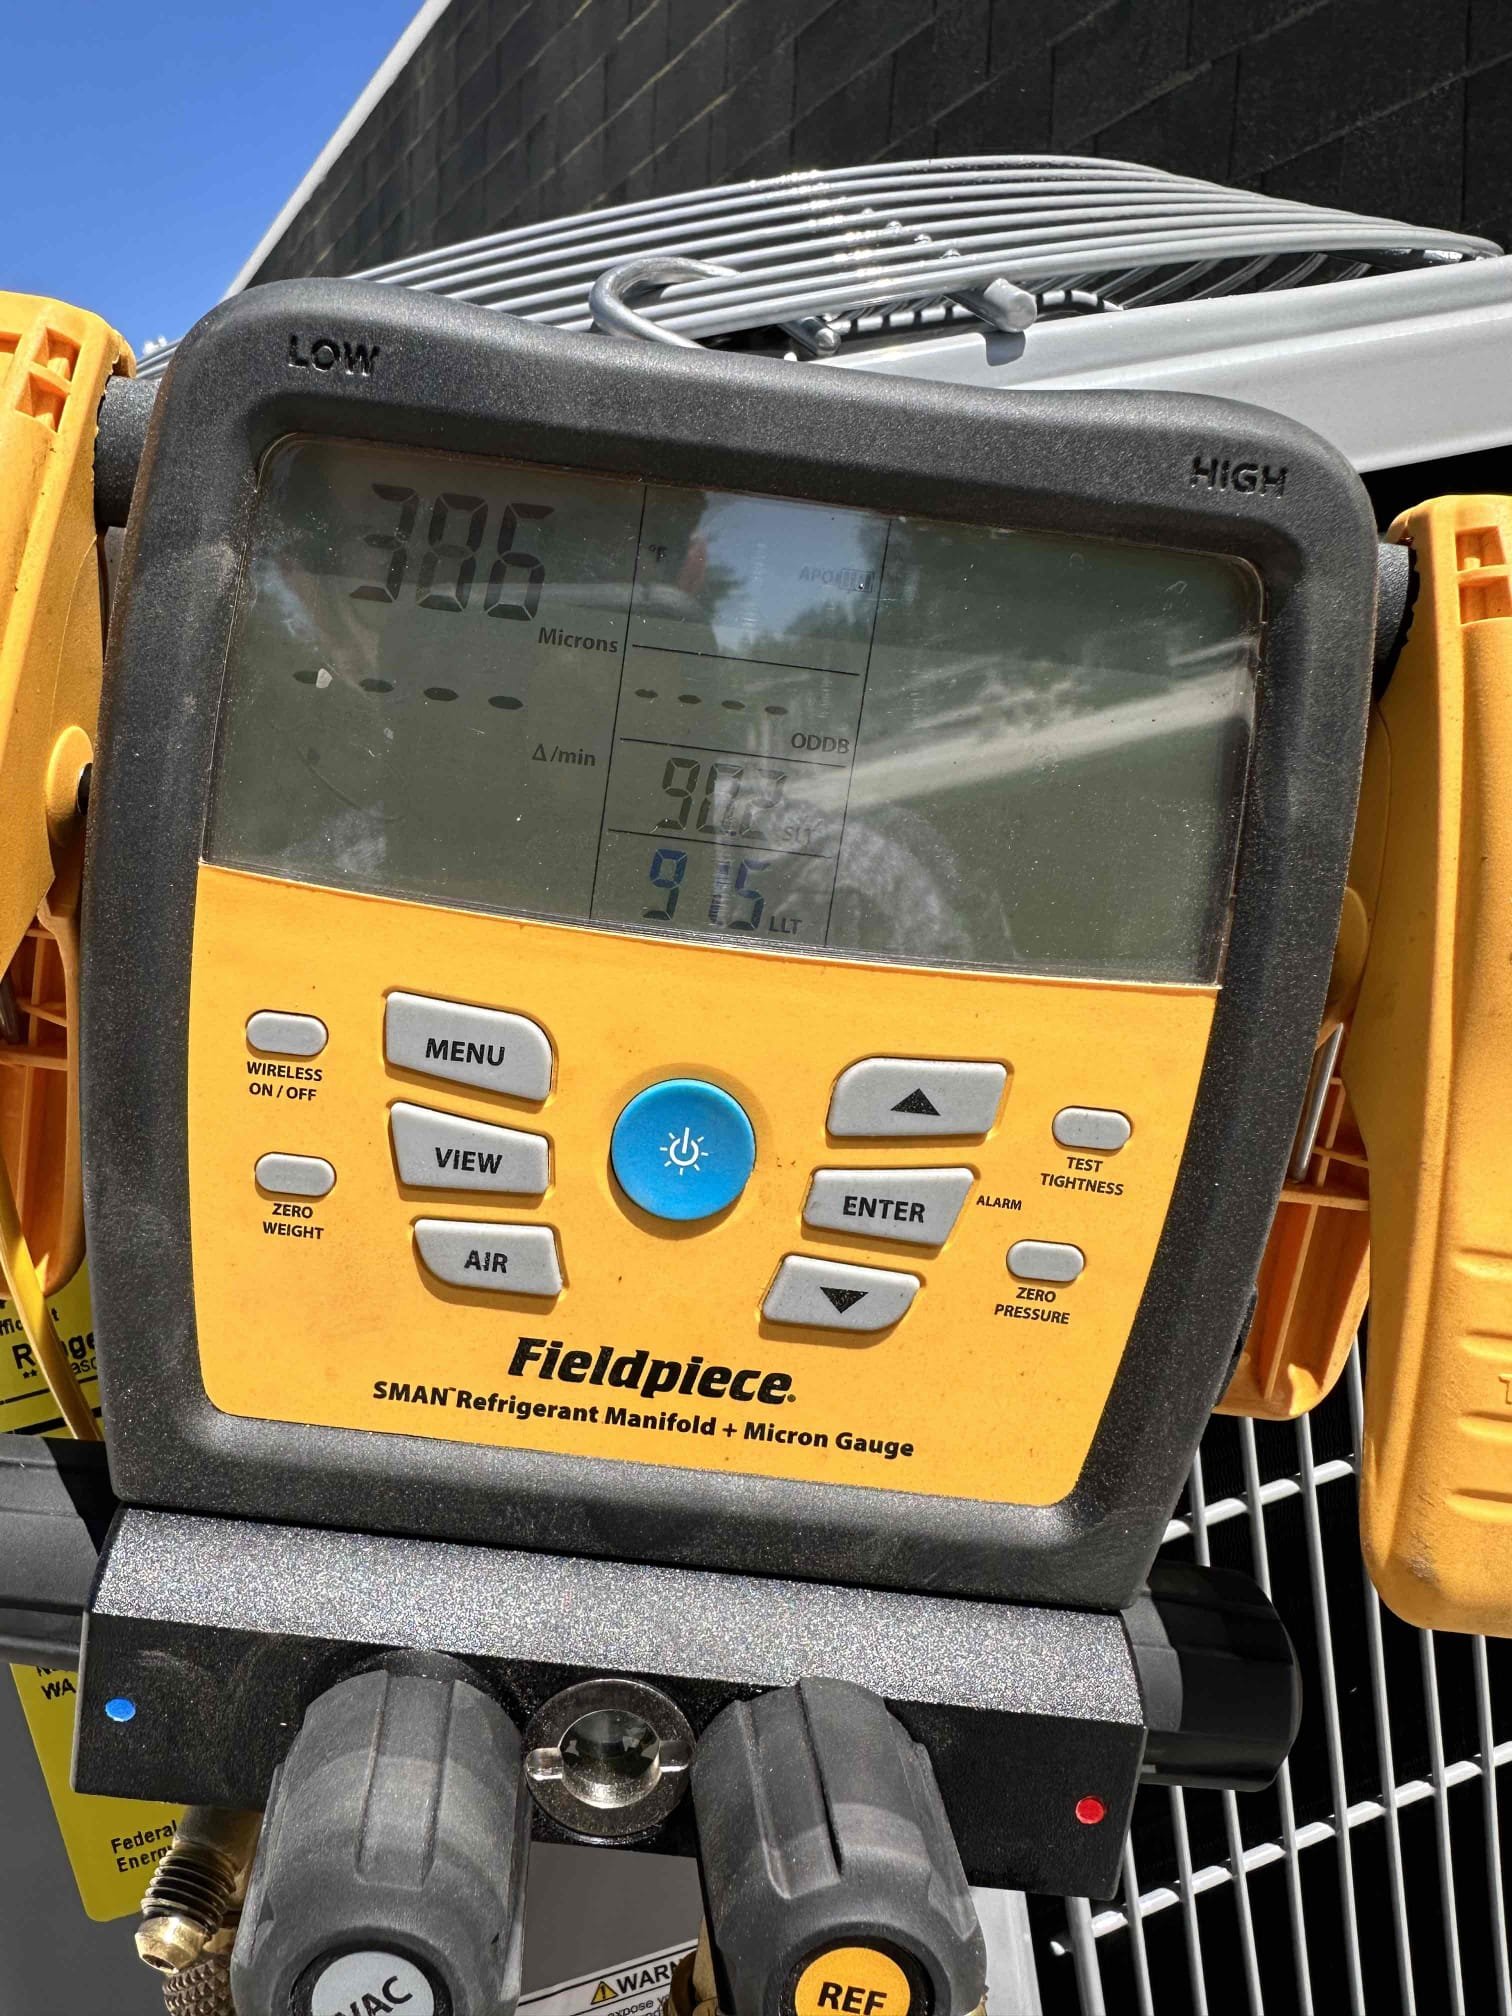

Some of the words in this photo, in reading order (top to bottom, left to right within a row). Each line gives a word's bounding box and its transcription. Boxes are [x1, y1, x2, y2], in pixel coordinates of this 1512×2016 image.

[288, 335, 381, 376] LOW
[1190, 457, 1288, 499] HIGH
[350, 483, 555, 621] 386
[538, 626, 619, 653] Microns
[791, 732, 850, 754] ODDB
[769, 915, 803, 934] LLT
[425, 1037, 506, 1067] MENU
[247, 1061, 323, 1082] WIRELESS
[249, 1083, 273, 1098] ON
[286, 1086, 317, 1101] OFF
[435, 1147, 503, 1174] VIEW
[1066, 1156, 1103, 1173] TEST
[1040, 1173, 1124, 1196] TIGHTNESS
[272, 1202, 313, 1219] ZERO
[842, 1195, 925, 1224] ENTER
[976, 1195, 1022, 1211] ALARM
[262, 1221, 324, 1240] WEIGHT
[464, 1250, 508, 1273] AIR
[1016, 1286, 1056, 1303] ZERO
[994, 1304, 1070, 1325] PRESSURE
[456, 1389, 598, 1424] Refrigerant
[604, 1406, 717, 1436] Manifold
[722, 1423, 737, 1438] +
[743, 1421, 829, 1448] Micron
[835, 1431, 915, 1460] Gauge
[111, 1820, 177, 1854] Federal
[117, 1845, 173, 1872] Energ
[817, 1981, 887, 2016] REF
